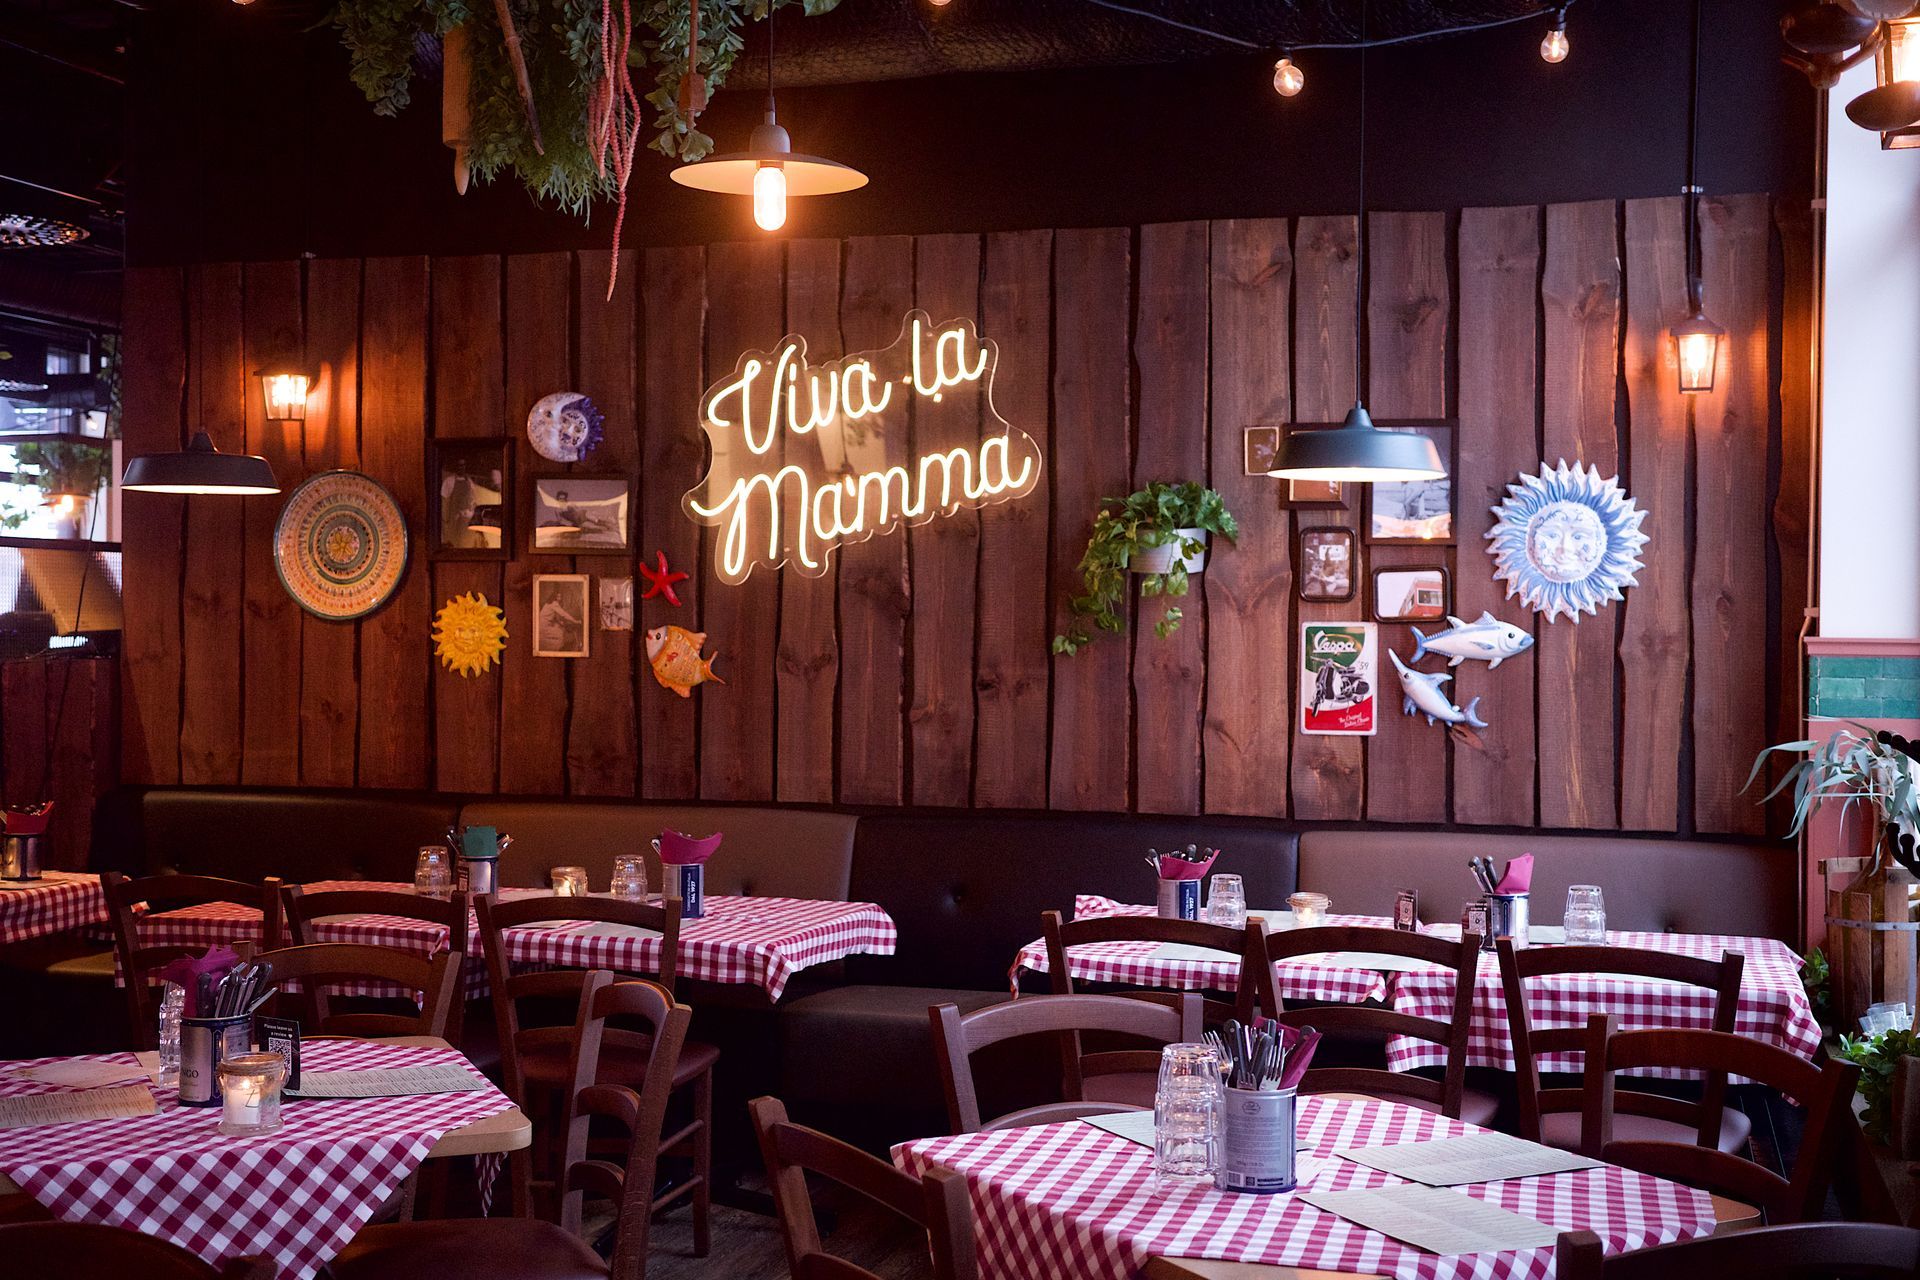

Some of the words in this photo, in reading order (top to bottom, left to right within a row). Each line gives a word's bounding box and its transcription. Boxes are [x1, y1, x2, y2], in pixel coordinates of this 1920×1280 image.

[707, 344, 892, 455] Viva
[912, 319, 988, 396] la
[690, 435, 1032, 576] Mamma
[1313, 630, 1357, 654] Vespa
